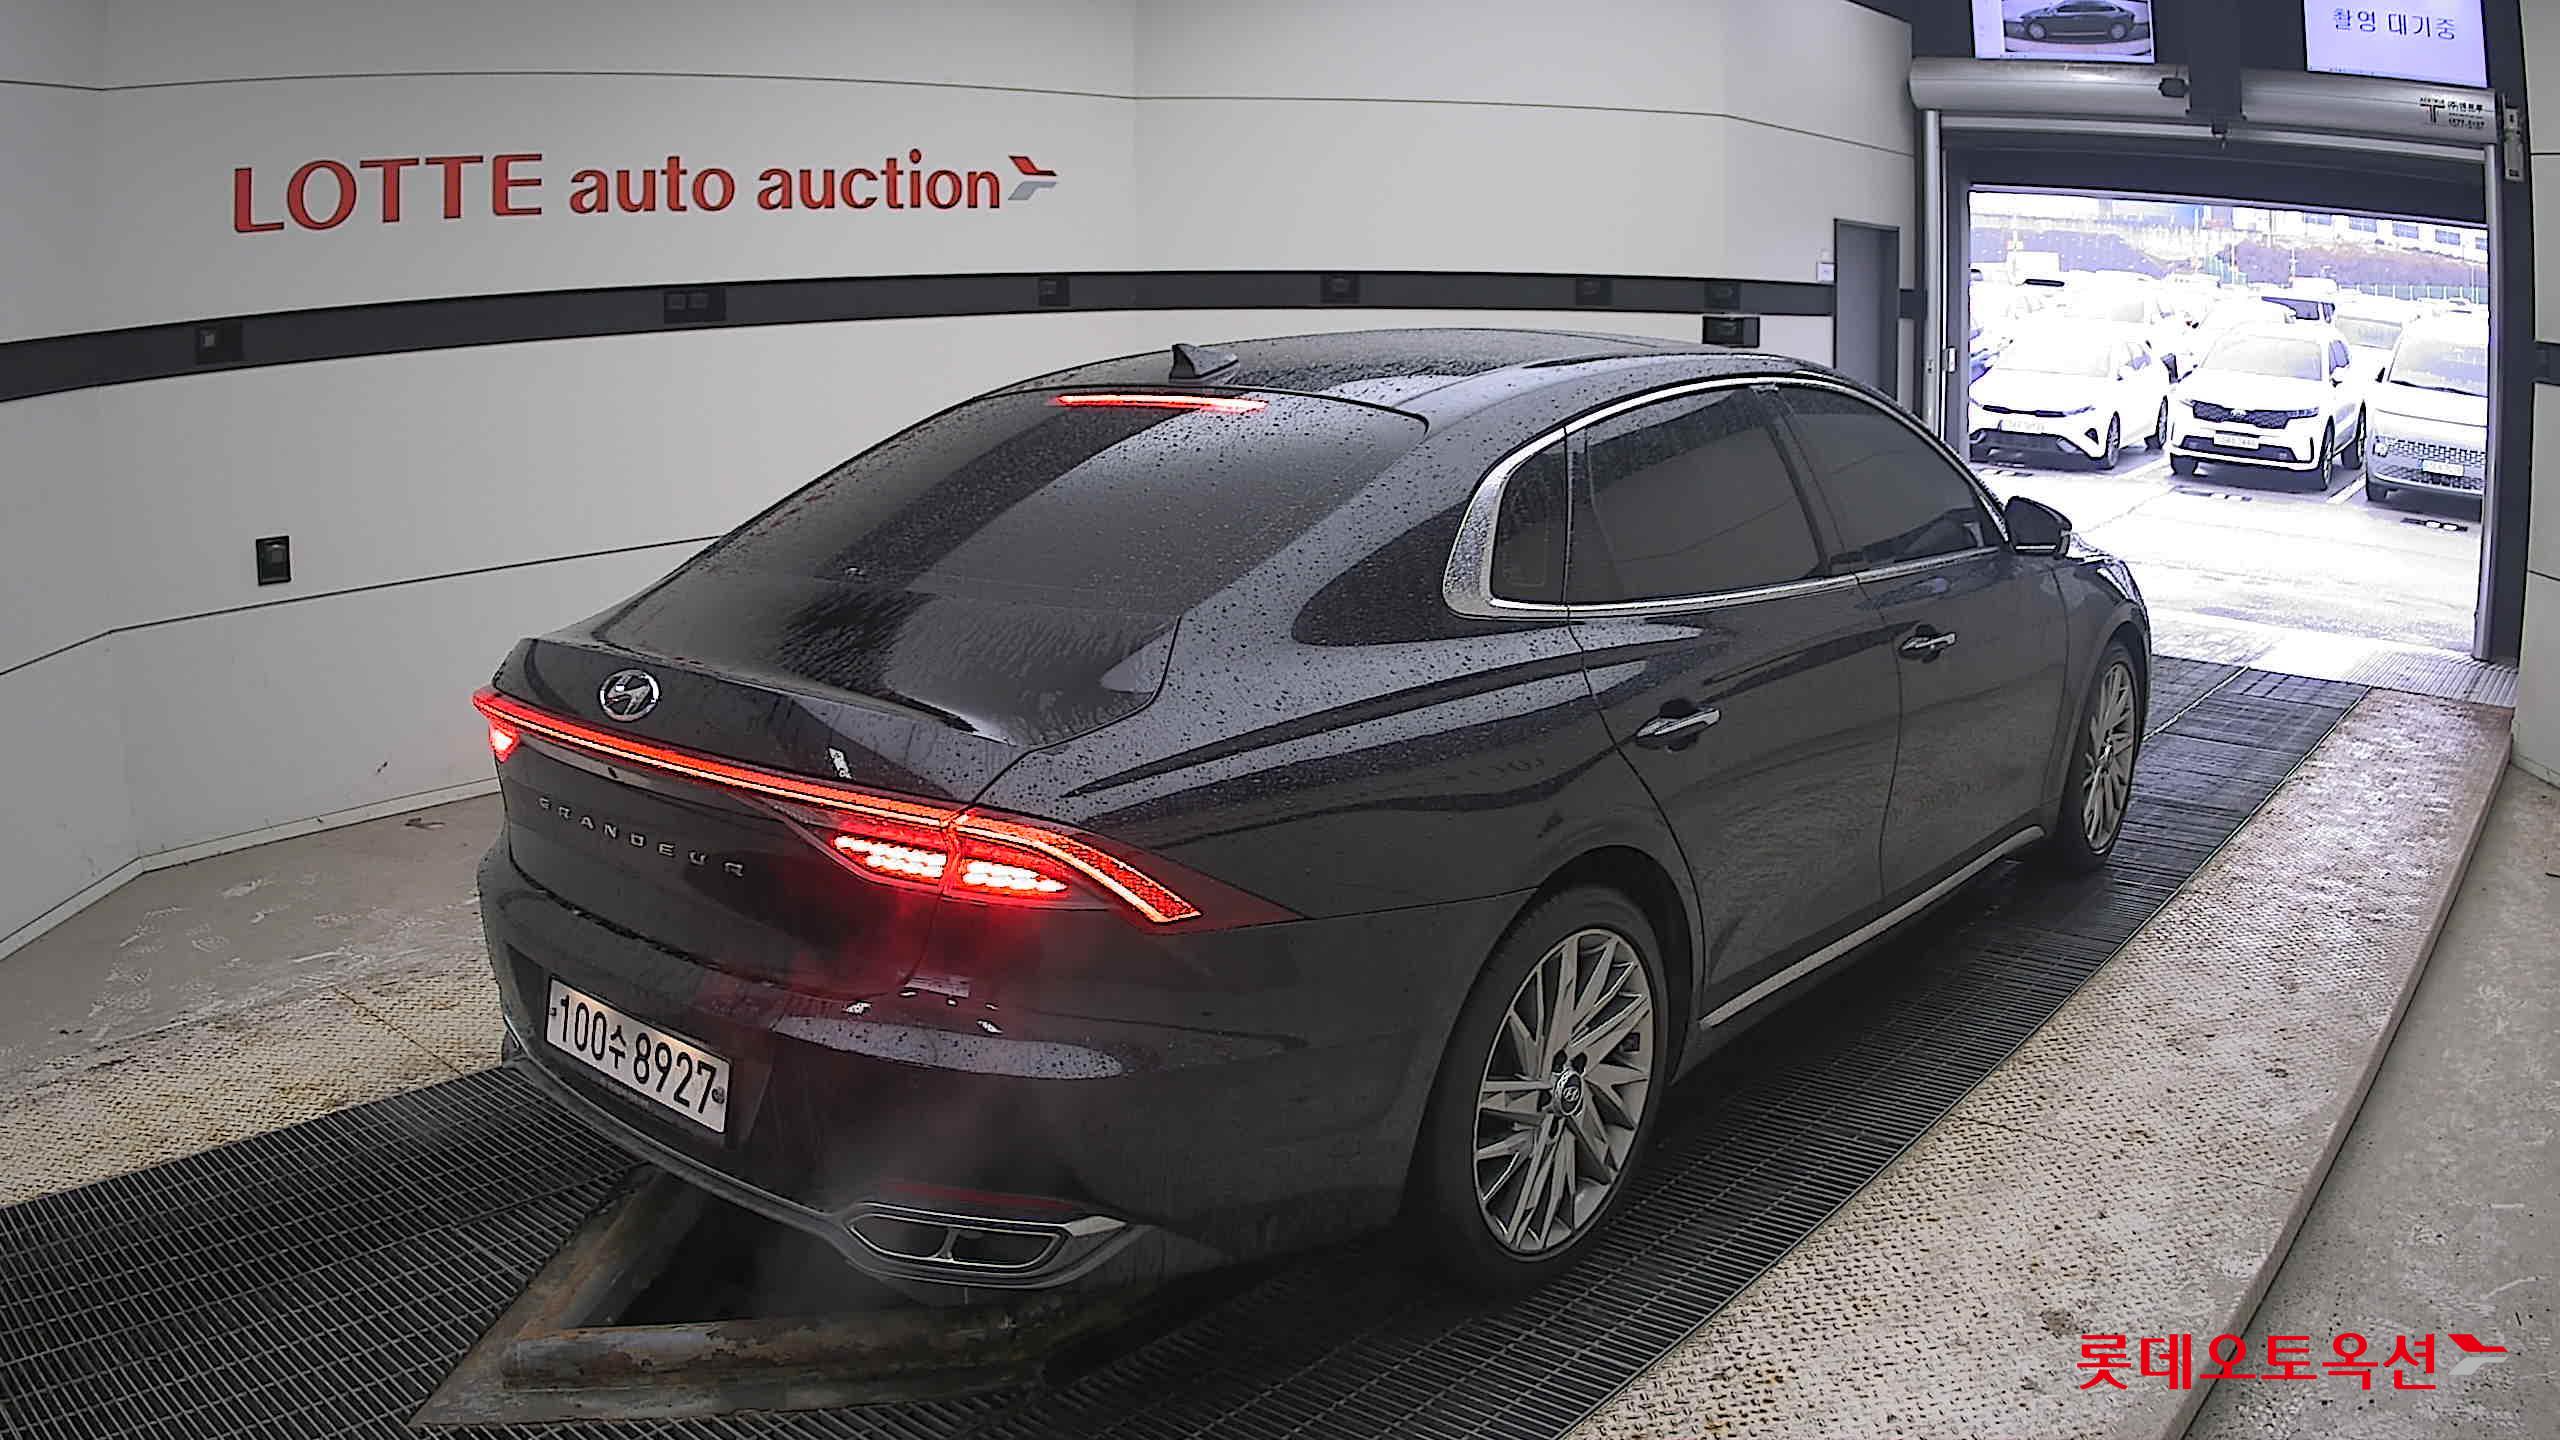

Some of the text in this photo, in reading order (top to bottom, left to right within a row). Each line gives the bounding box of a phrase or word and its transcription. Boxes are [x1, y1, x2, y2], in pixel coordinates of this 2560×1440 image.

[2333, 7, 2456, 40] 촬영 대기중
[234, 148, 1002, 233] LOTTE auto auction
[538, 796, 744, 877] GRANDEUR
[560, 994, 717, 1114] 100수8927
